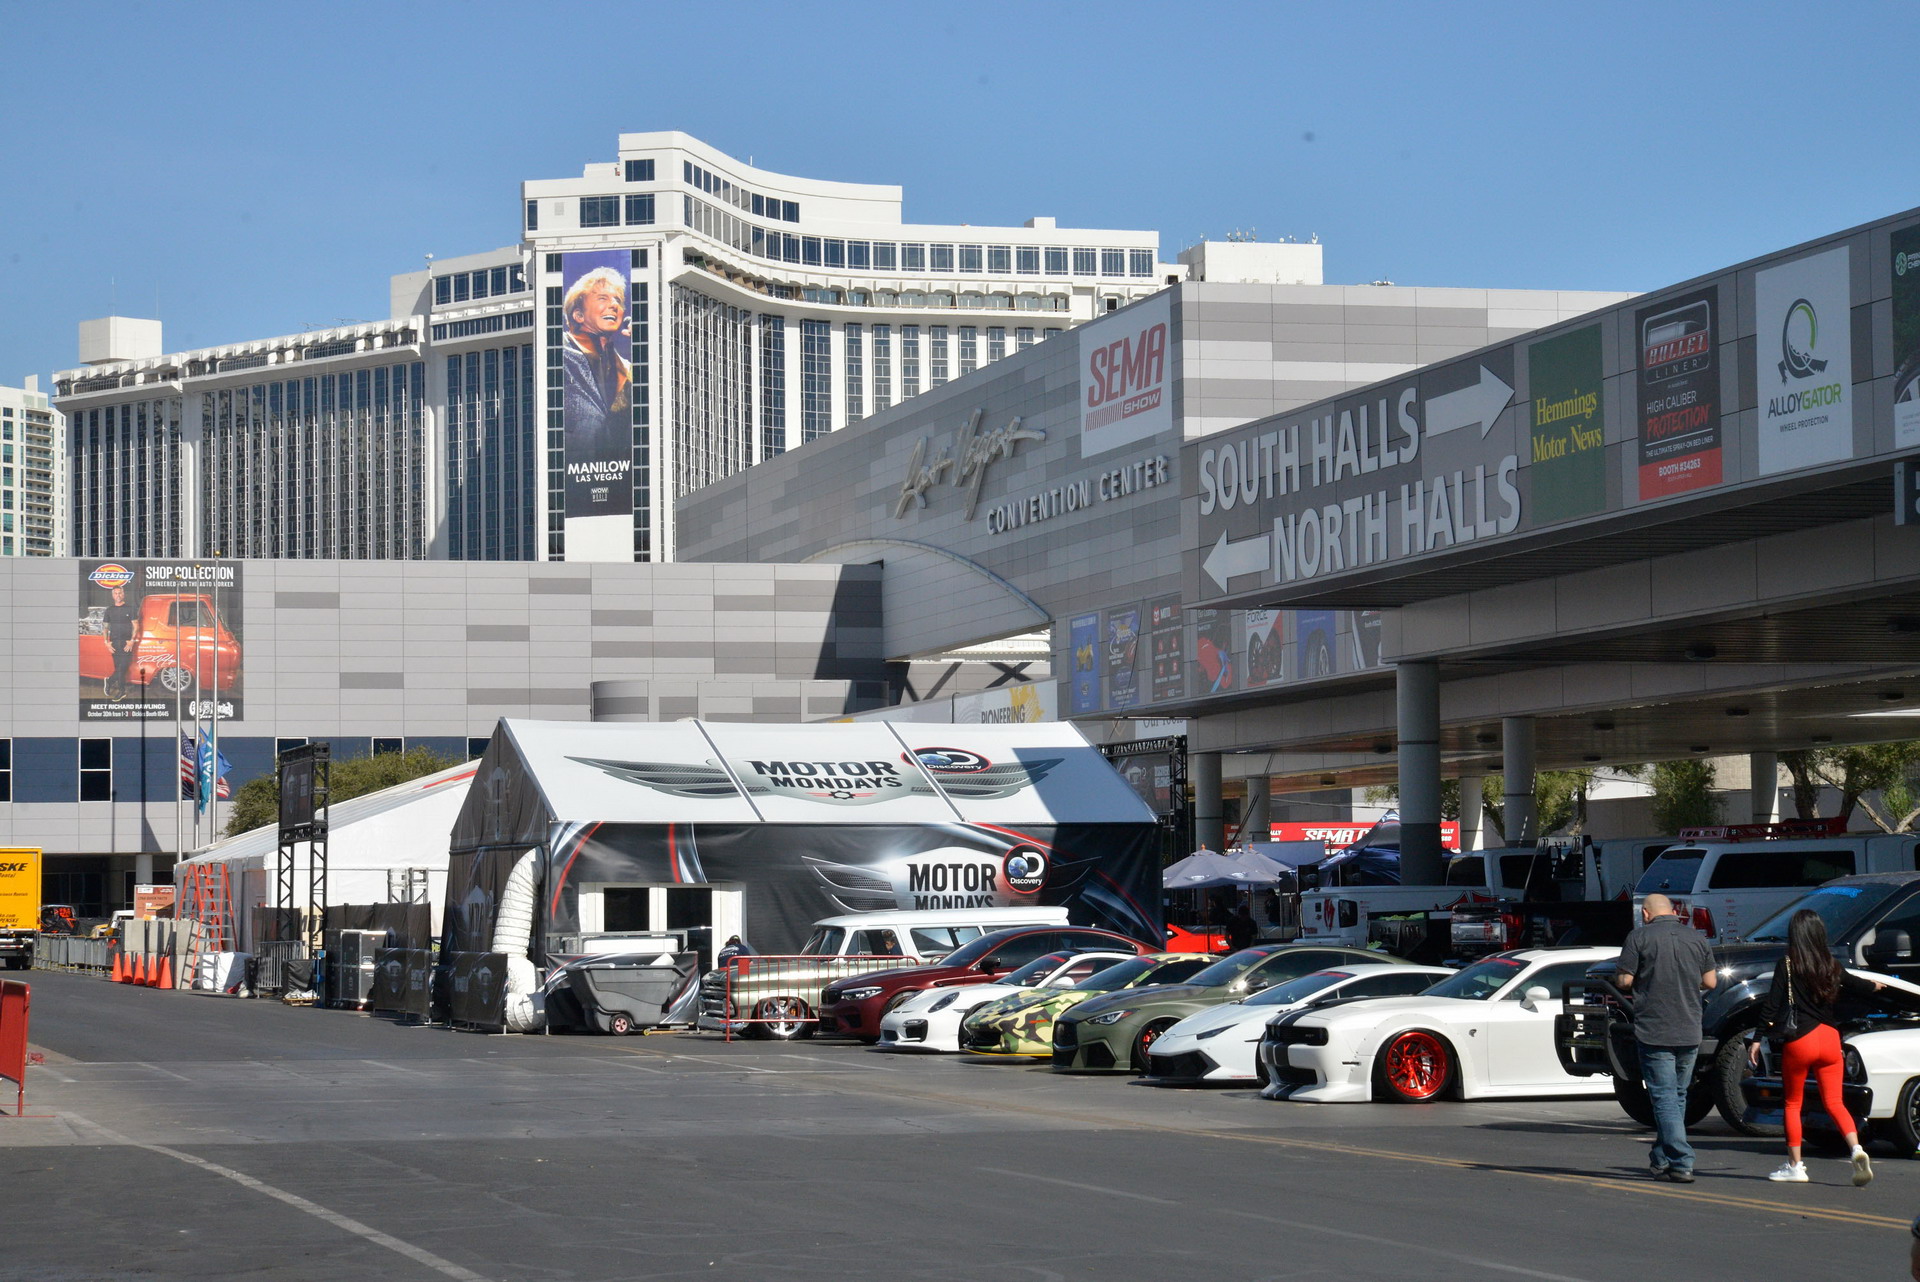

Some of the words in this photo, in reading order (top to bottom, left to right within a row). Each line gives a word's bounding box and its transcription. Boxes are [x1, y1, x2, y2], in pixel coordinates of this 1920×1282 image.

[1649, 334, 1705, 366] BULLET
[1088, 322, 1166, 407] SEMA
[1656, 360, 1698, 379] LINER
[1124, 391, 1160, 415] SHOW
[1536, 388, 1597, 426] Hemmings
[1646, 399, 1664, 415] HIGH
[1665, 390, 1697, 409] CALIBER
[1767, 383, 1842, 418] ALLOYGATOR
[1646, 405, 1711, 440] PROTECTION
[1780, 422, 1798, 432] WHEEL
[1798, 415, 1829, 429] PROTECTION
[1200, 425, 1300, 517] SOUTH
[1312, 387, 1420, 487] HALLS
[1532, 434, 1567, 463] Motor
[1570, 424, 1602, 453] News
[1654, 445, 1673, 456] ULTIMATE
[1693, 438, 1701, 447] BED
[1702, 435, 1714, 445] LINER
[568, 460, 630, 475] MANILOW
[576, 474, 591, 483] LAS
[594, 472, 623, 482] VEGAS
[1659, 462, 1679, 477] BOOTH
[986, 480, 1092, 535] CONVENTION
[1099, 455, 1169, 502] CENTER
[1274, 490, 1388, 583] NORTH
[1401, 455, 1521, 556] HALLS
[146, 566, 171, 579] SHOP
[175, 566, 234, 580] COLLECTION
[981, 704, 1026, 723] PIONEERING
[745, 760, 901, 776] MOTOR
[927, 763, 982, 771] Discovery
[770, 776, 903, 789] MONDAYS
[907, 863, 998, 892] MOTOR
[1010, 877, 1043, 886] Discovery
[914, 895, 996, 910] MONDAYS
